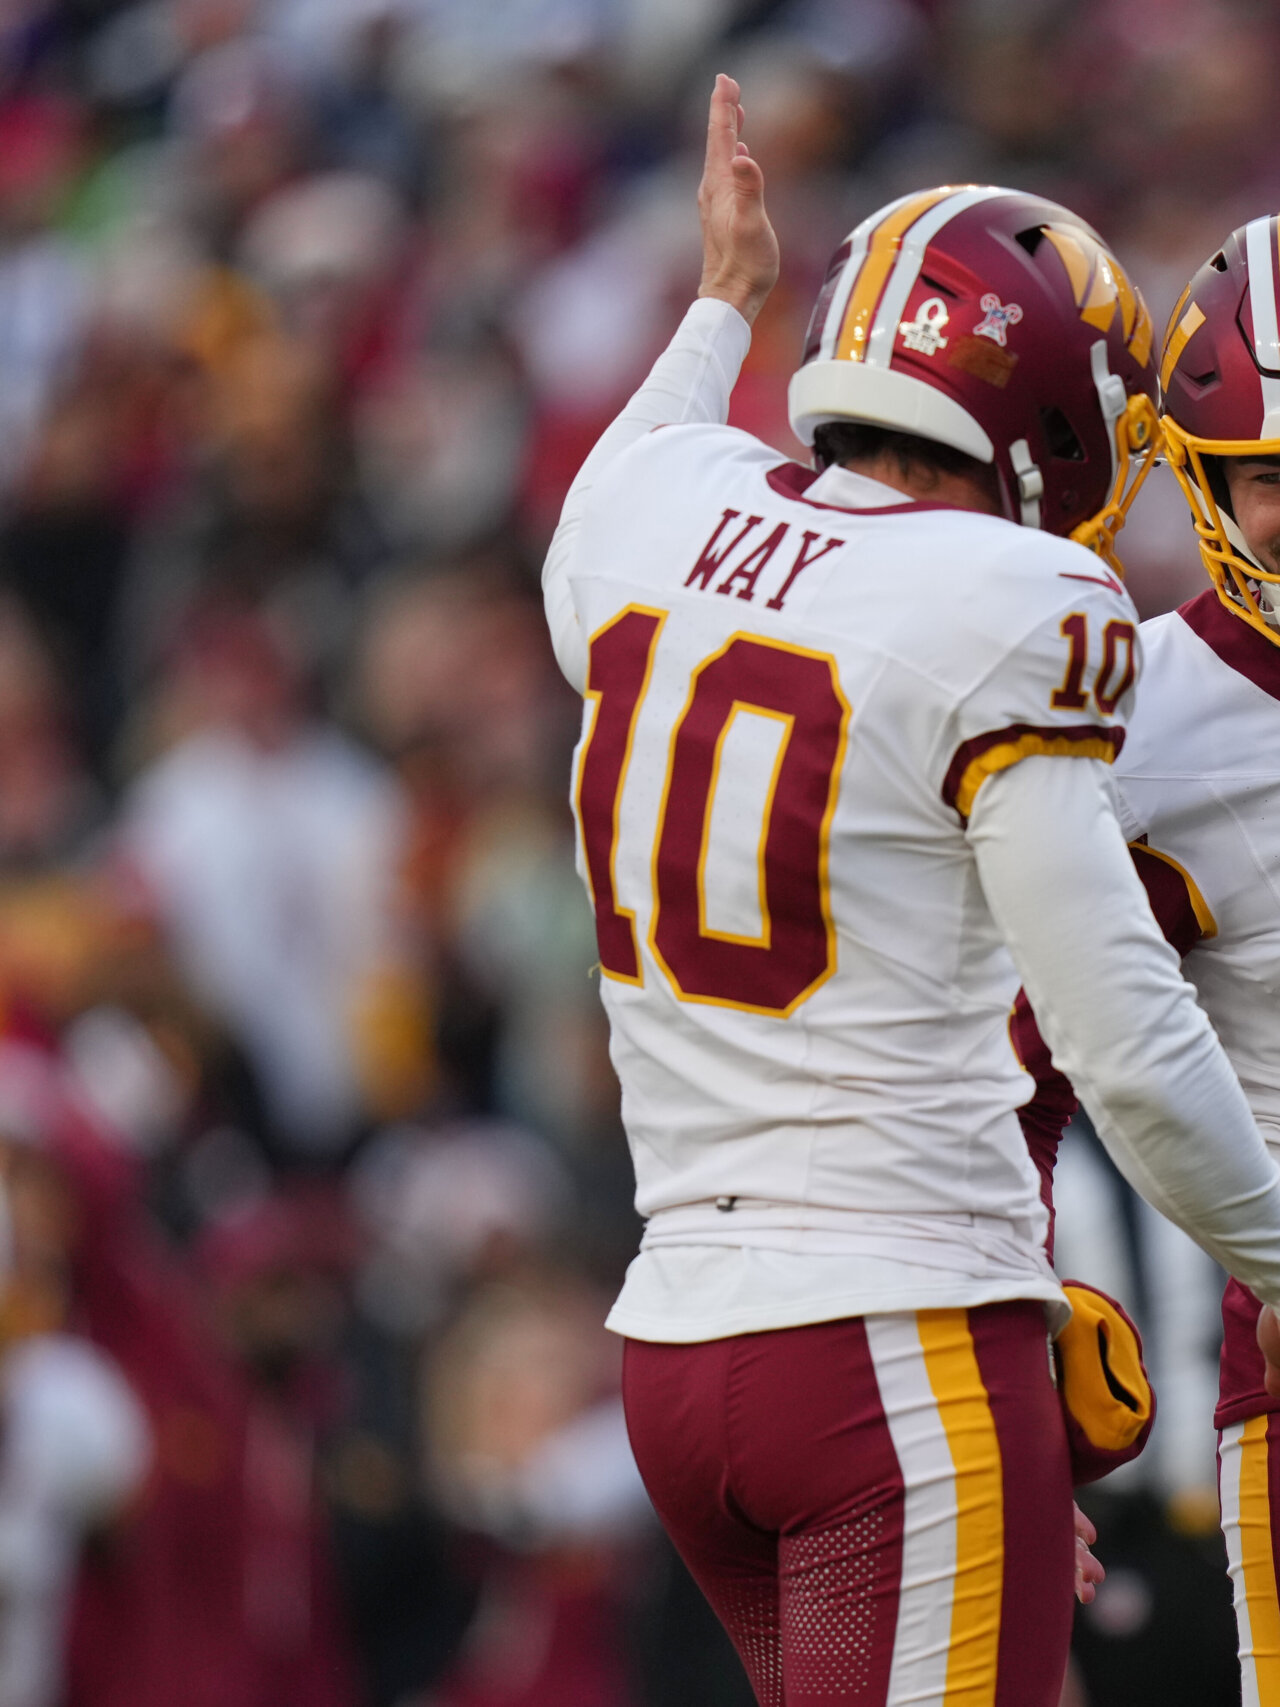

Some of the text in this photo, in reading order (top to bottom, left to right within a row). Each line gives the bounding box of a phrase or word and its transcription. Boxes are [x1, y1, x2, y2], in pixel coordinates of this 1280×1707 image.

[683, 508, 846, 612] WAY
[1049, 612, 1135, 717] 10
[576, 602, 853, 1020] 10
